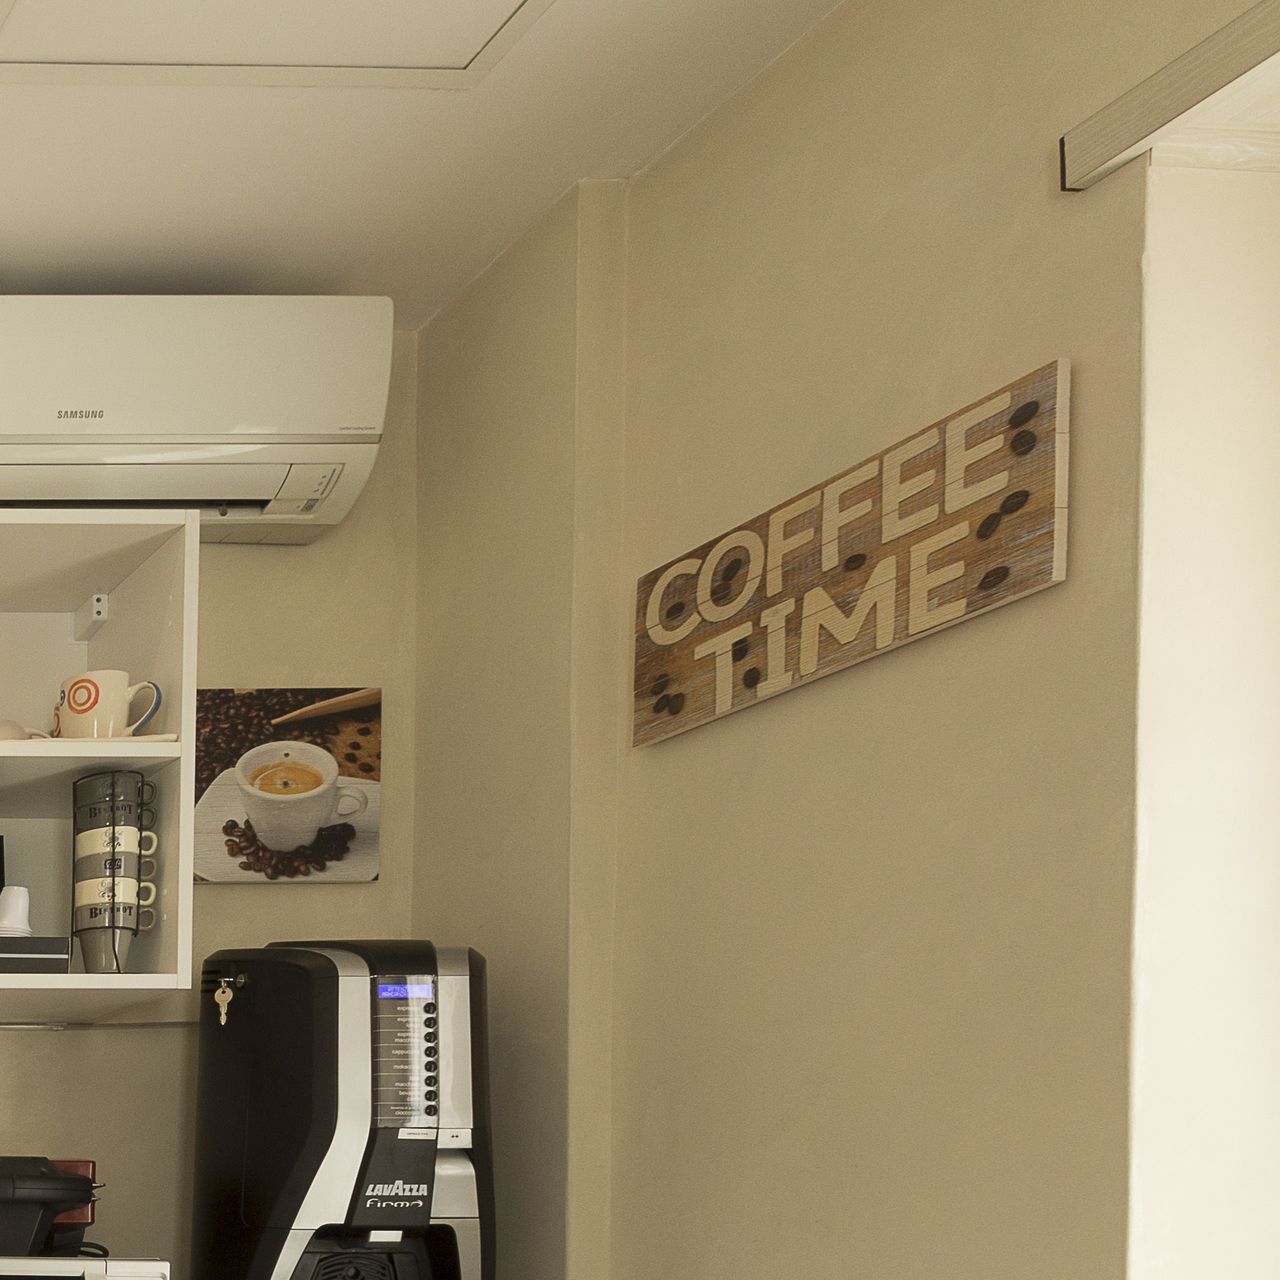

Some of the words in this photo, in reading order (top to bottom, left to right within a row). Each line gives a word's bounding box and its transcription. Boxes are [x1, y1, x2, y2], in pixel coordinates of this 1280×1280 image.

[57, 410, 104, 419] SAMSUNG
[645, 392, 1011, 646] COFFEE
[693, 520, 970, 716] TIME
[365, 1180, 428, 1196] LAVAZZA
